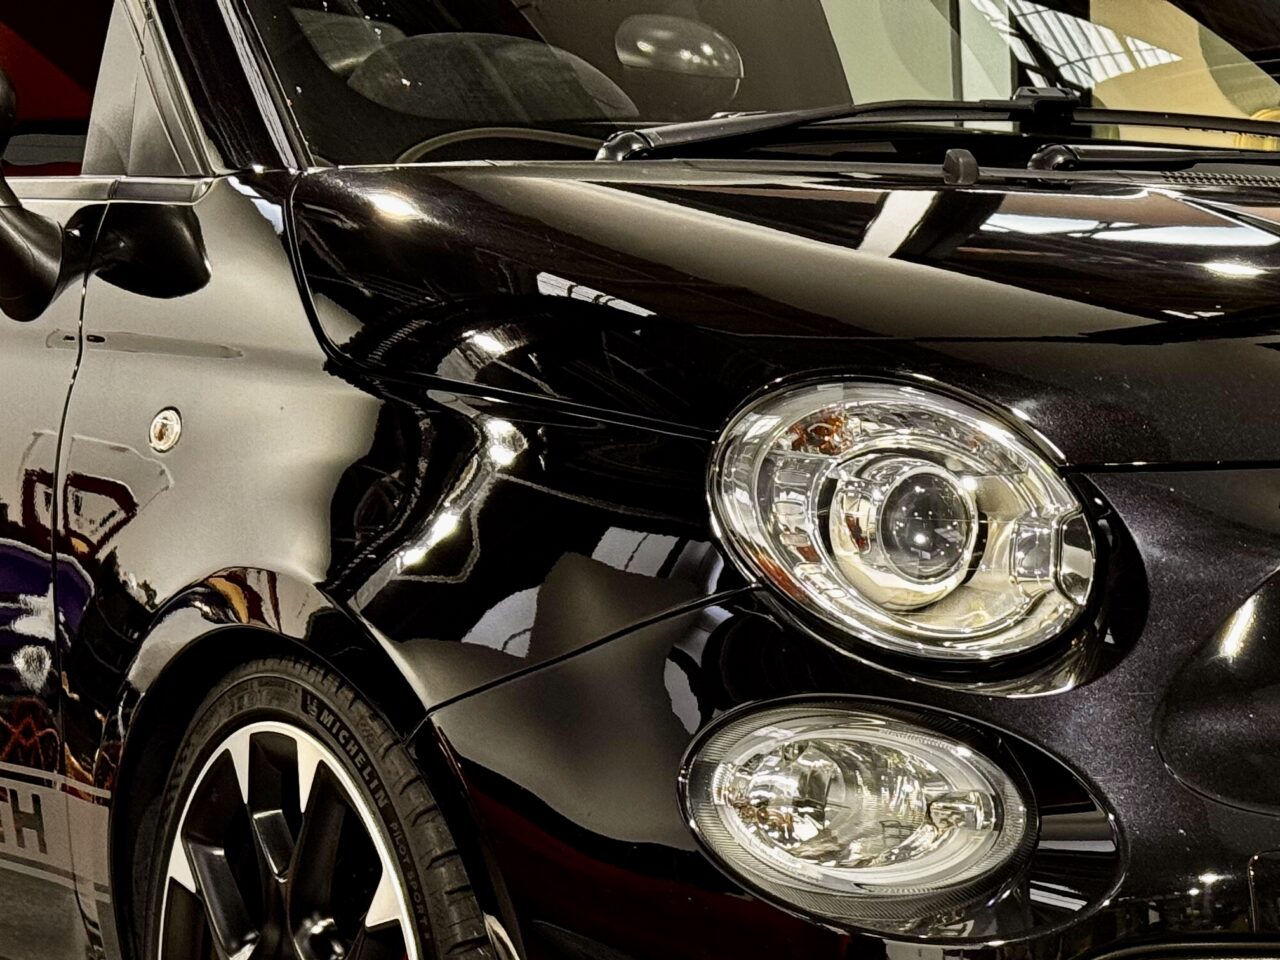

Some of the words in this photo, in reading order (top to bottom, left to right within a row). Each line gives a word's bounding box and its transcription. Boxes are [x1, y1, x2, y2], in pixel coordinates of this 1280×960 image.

[319, 707, 389, 809] MICHELIN
[0, 786, 48, 855] H
[389, 821, 411, 865] PILOT
[407, 870, 429, 926] SPORT
